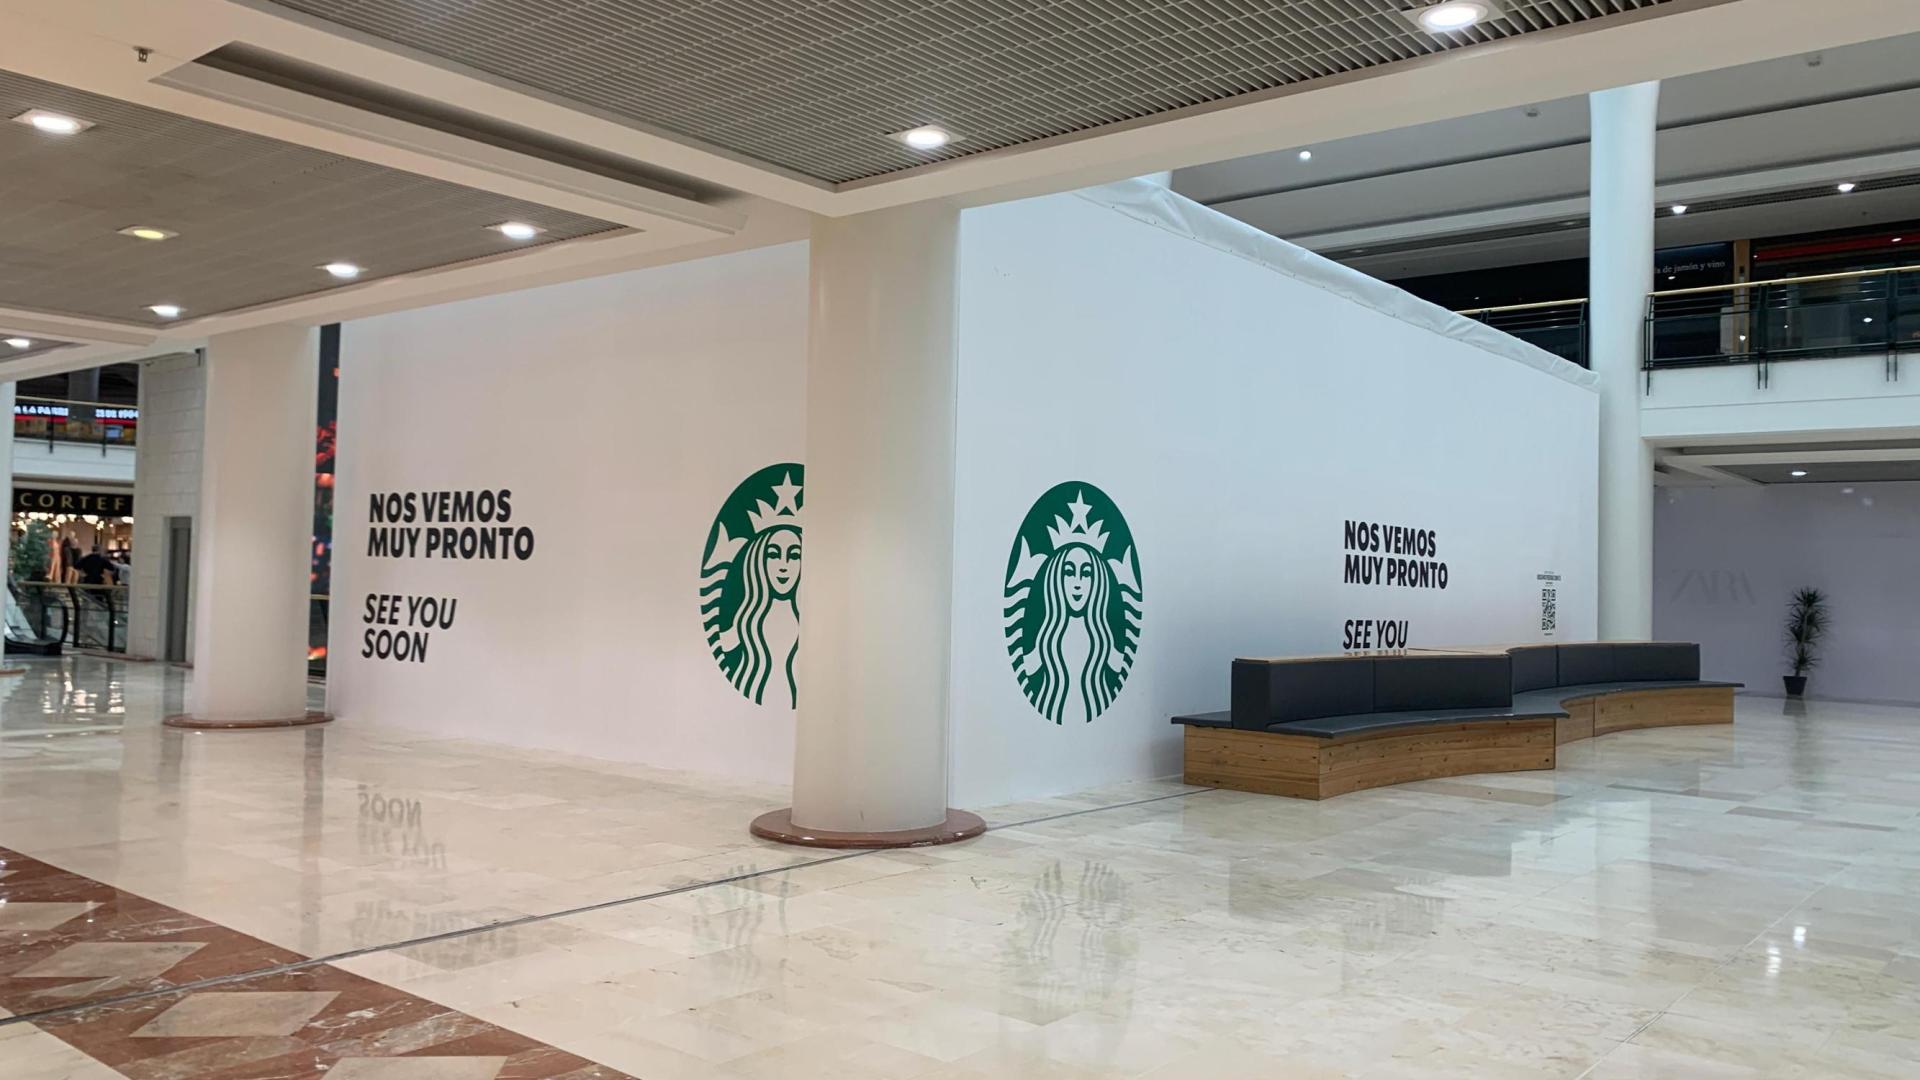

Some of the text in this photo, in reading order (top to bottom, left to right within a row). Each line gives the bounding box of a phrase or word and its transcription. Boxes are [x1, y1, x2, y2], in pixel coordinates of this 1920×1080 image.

[1662, 265, 1672, 273] de
[1707, 260, 1726, 268] vino
[20, 492, 125, 511] CORTEF
[370, 489, 511, 523] NOS VEMOS
[367, 527, 534, 560] MUY PRONTO
[1345, 520, 1436, 557] NOS VEMOS
[1344, 554, 1448, 589] MUY PRONTO
[363, 594, 457, 629] SEE YOU
[362, 628, 429, 662] SOON
[1343, 620, 1408, 649] SEE YOU
